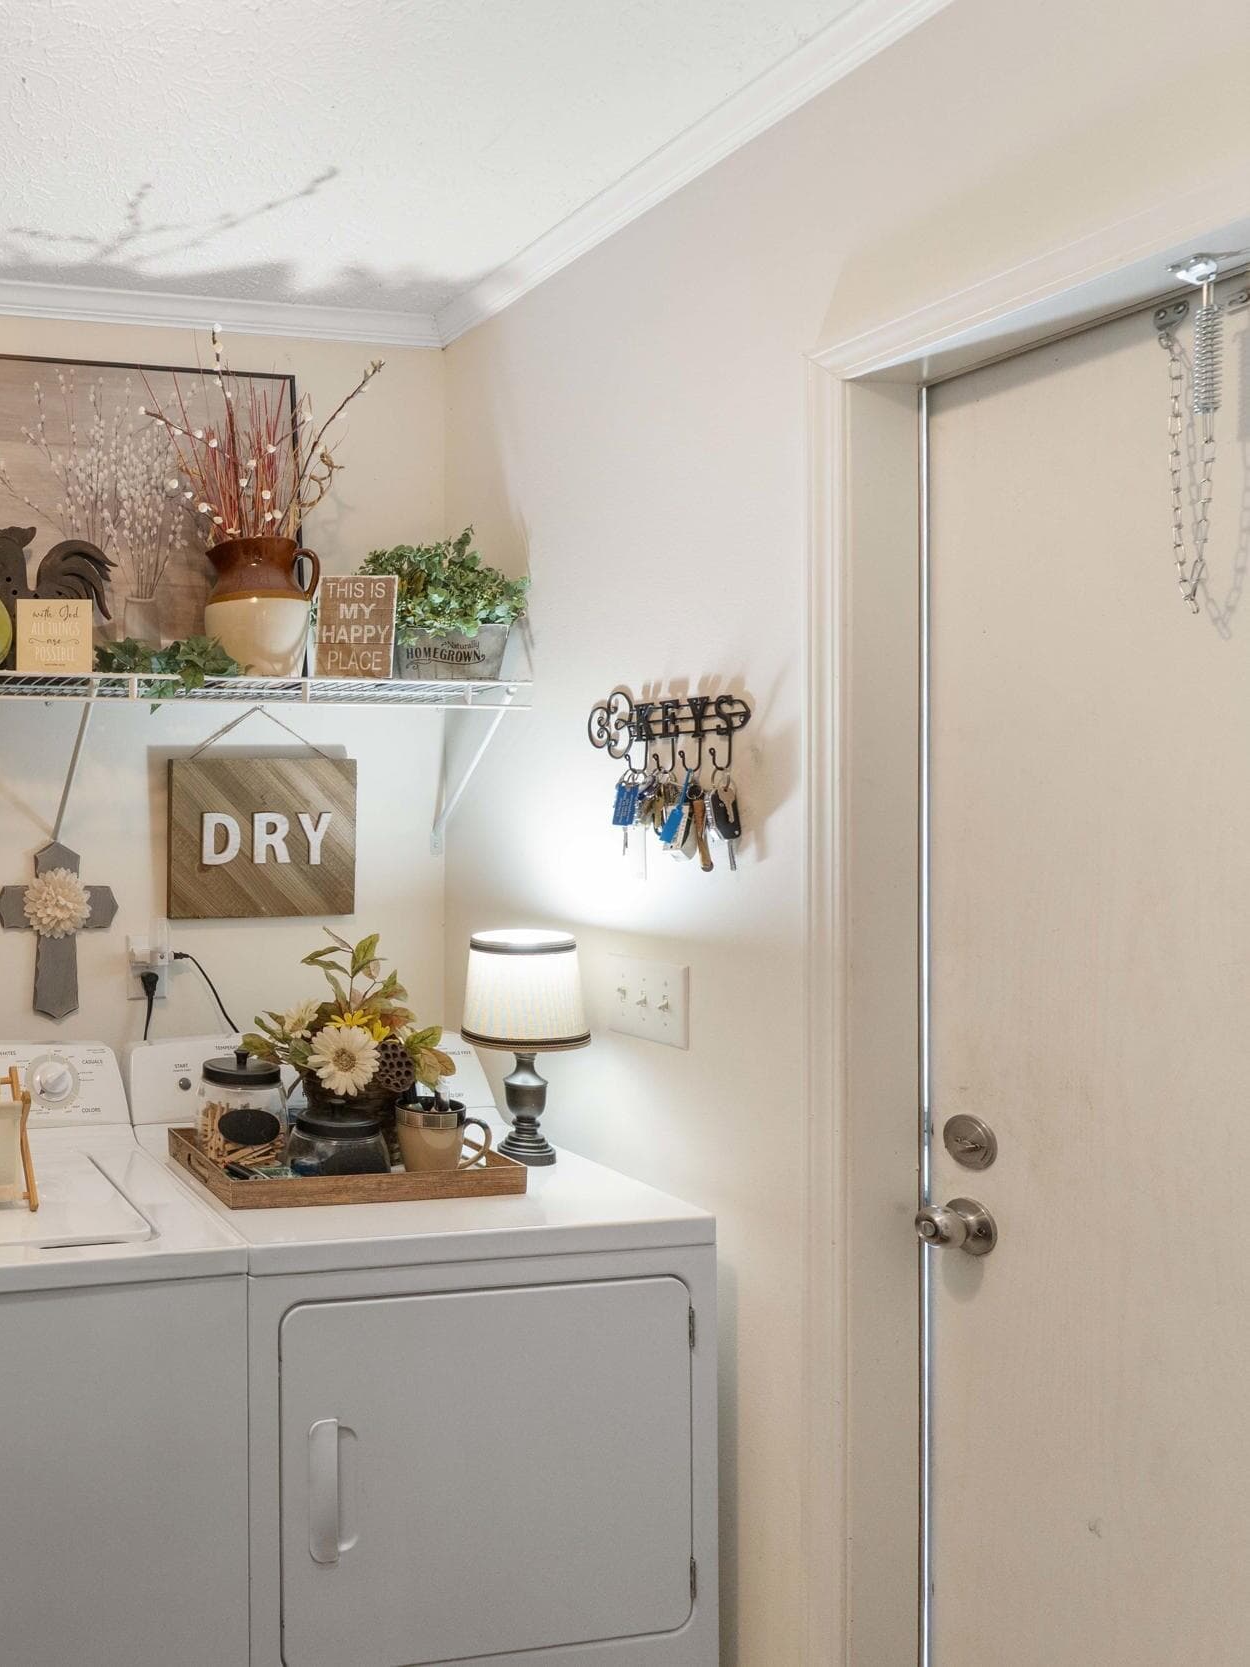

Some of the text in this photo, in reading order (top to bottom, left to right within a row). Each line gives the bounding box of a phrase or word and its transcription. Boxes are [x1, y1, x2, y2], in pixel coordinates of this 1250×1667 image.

[326, 582, 386, 599] THIS IS
[32, 604, 79, 621] with God
[339, 603, 377, 619] MY
[322, 625, 389, 644] HAPPY
[448, 640, 480, 650] Naturally
[327, 651, 383, 671] PLACE
[406, 648, 482, 663] HOMEGROWN
[634, 694, 734, 742] KEYS
[201, 811, 332, 866] DRY
